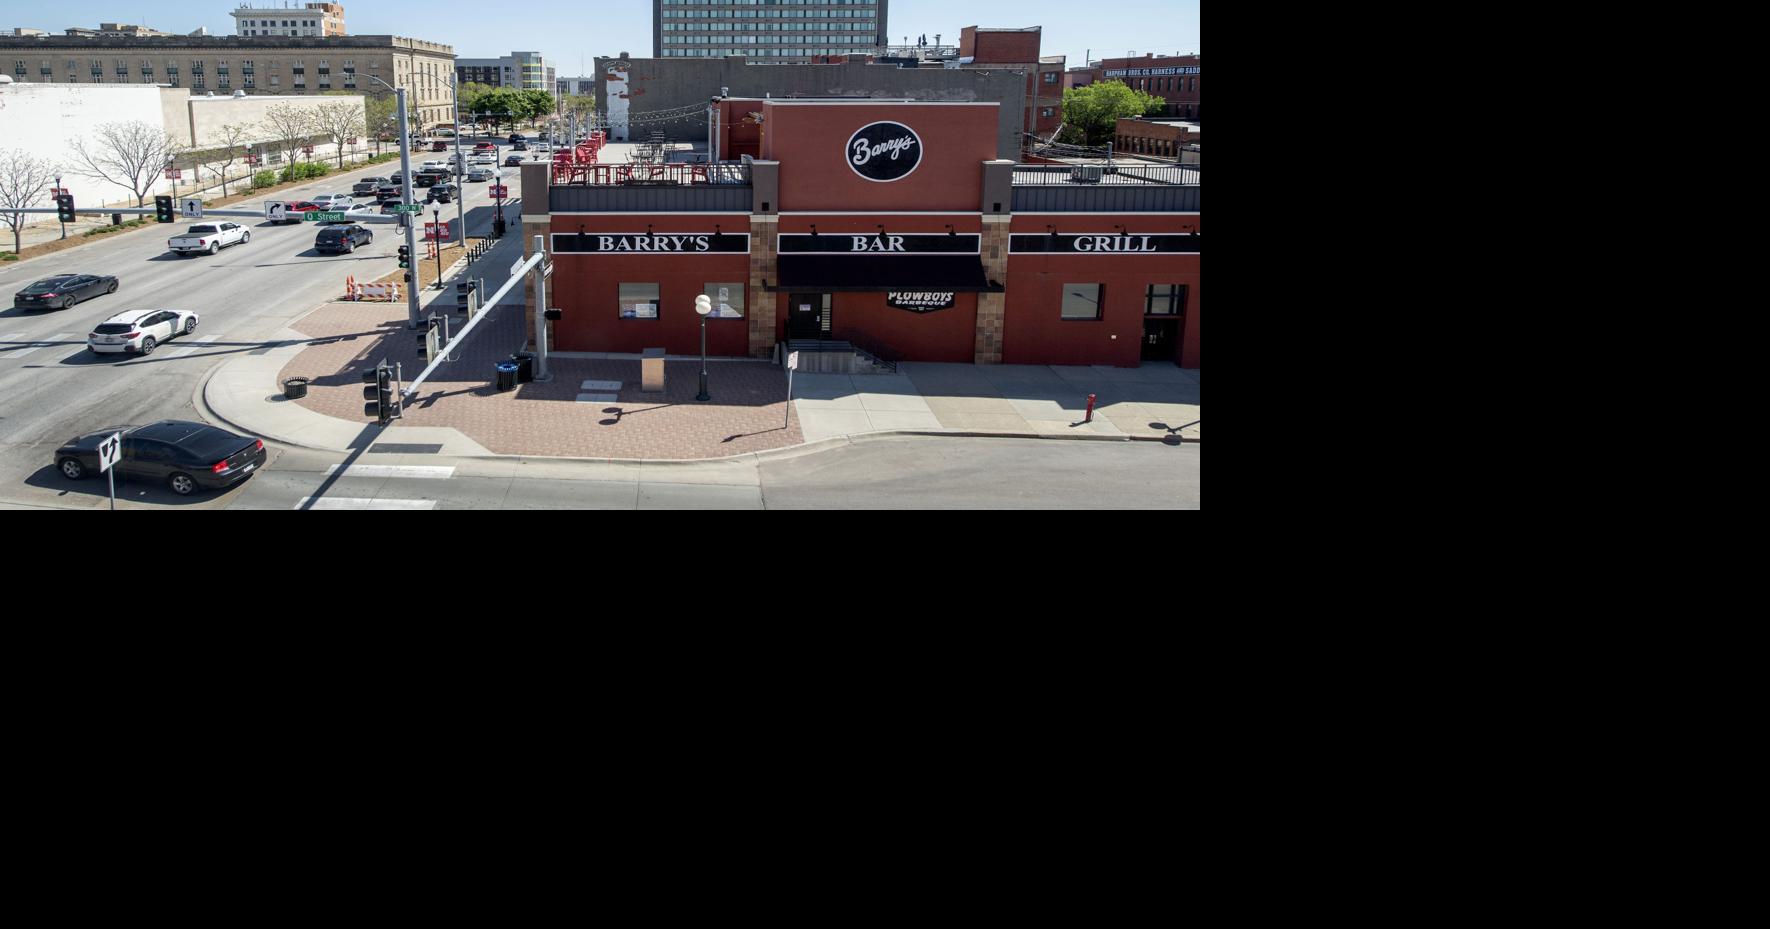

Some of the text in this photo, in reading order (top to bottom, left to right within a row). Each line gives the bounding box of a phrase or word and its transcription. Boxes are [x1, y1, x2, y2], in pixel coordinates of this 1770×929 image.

[853, 135, 916, 165] Barry's
[598, 236, 710, 251] BARRY'S
[850, 236, 906, 252] BAR
[1074, 236, 1156, 252] GRILL
[888, 292, 954, 302] PLOWBOYS
